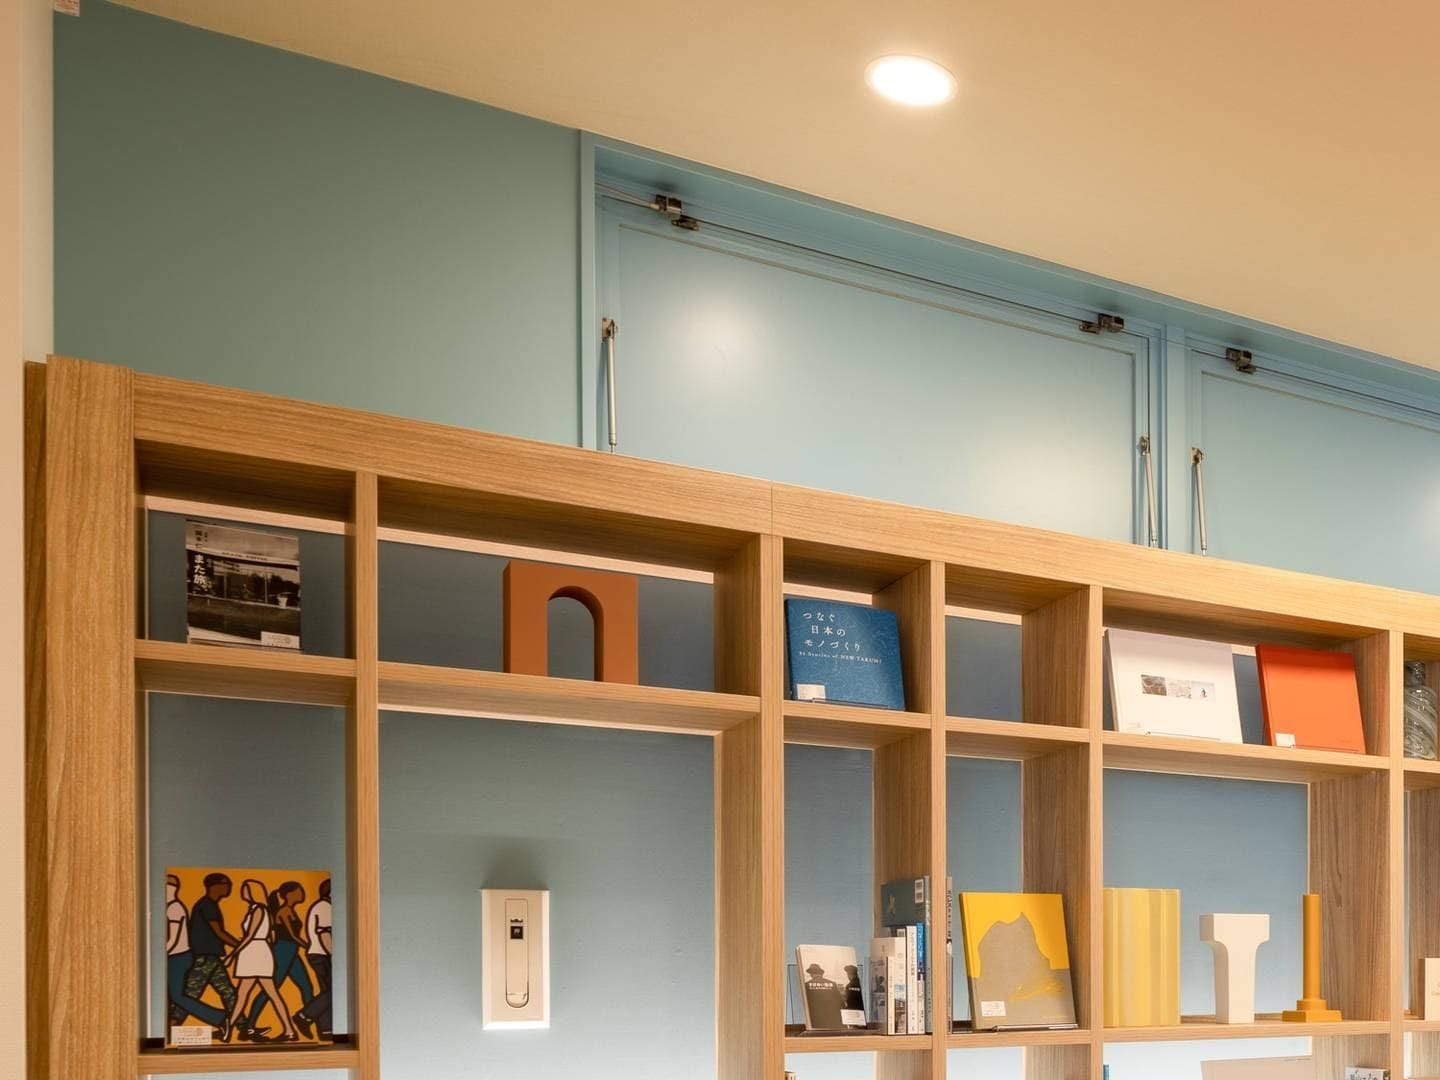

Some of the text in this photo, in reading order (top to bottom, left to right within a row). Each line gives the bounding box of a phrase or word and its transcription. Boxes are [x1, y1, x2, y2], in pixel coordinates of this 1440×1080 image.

[803, 612, 836, 623] つなぐ
[811, 625, 846, 637] 日本の
[804, 639, 861, 652] モノづくり
